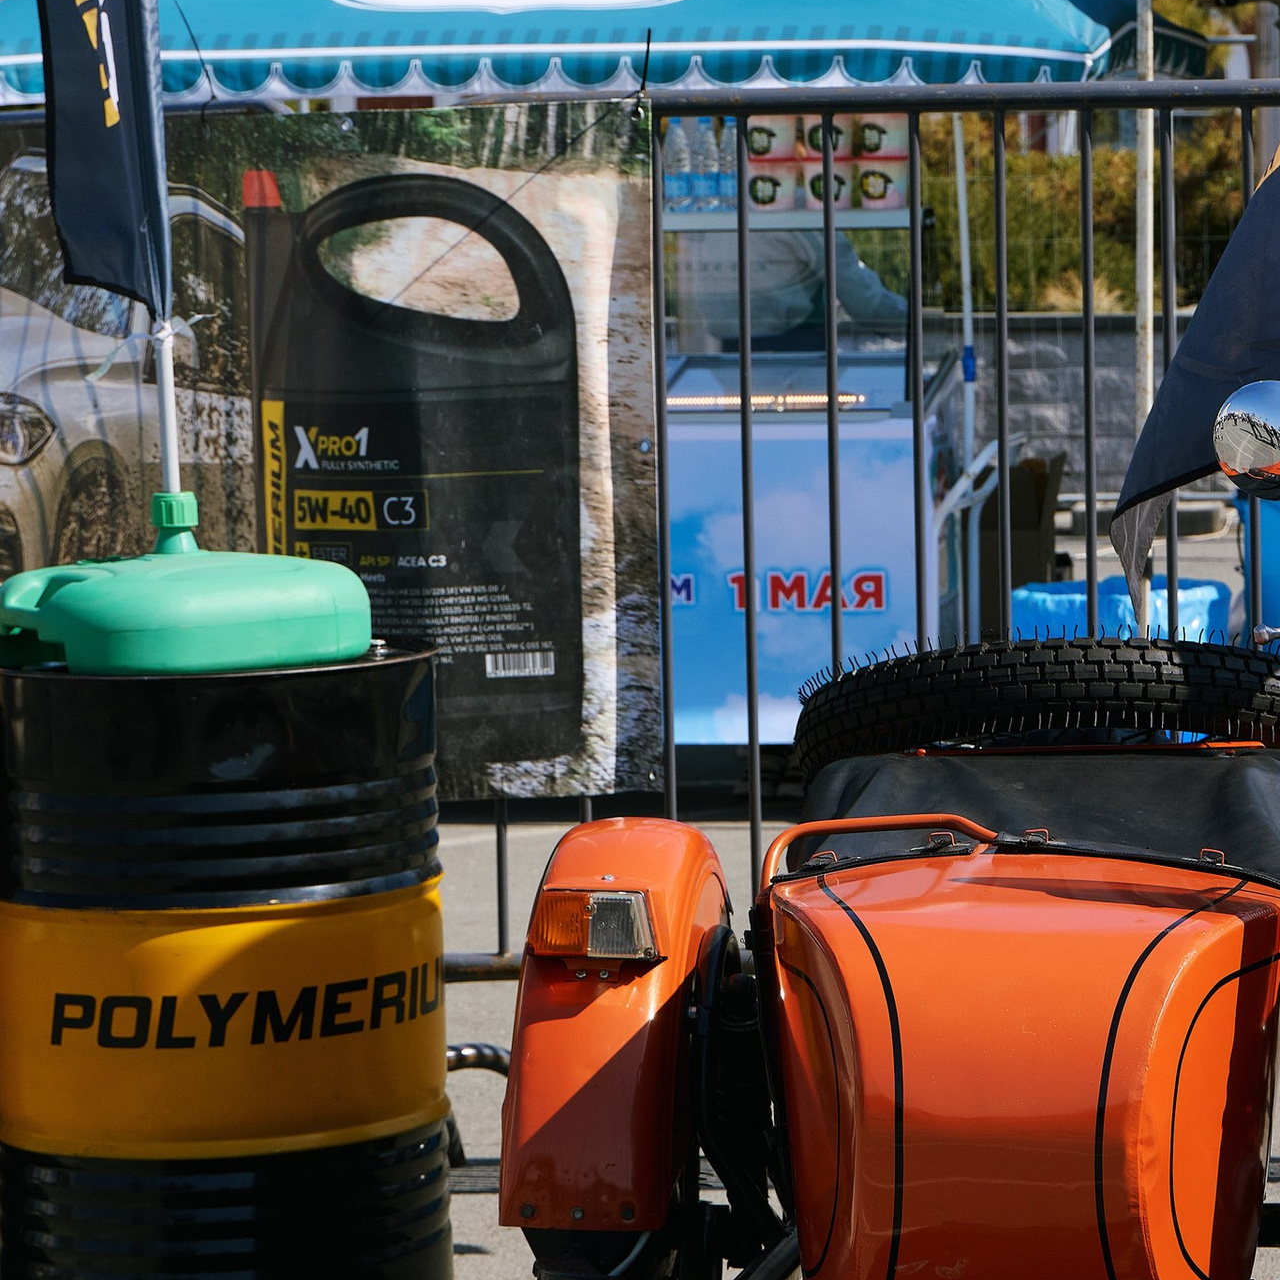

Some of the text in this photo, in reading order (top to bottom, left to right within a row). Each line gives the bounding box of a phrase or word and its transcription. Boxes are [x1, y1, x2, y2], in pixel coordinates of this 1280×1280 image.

[321, 459, 400, 470] FULLY SYNTHETIC
[297, 495, 372, 524] 5W-40
[382, 496, 416, 525] C3
[312, 546, 348, 561] ESTER
[397, 555, 447, 568] ACEA C3
[768, 572, 885, 609] МАЯ
